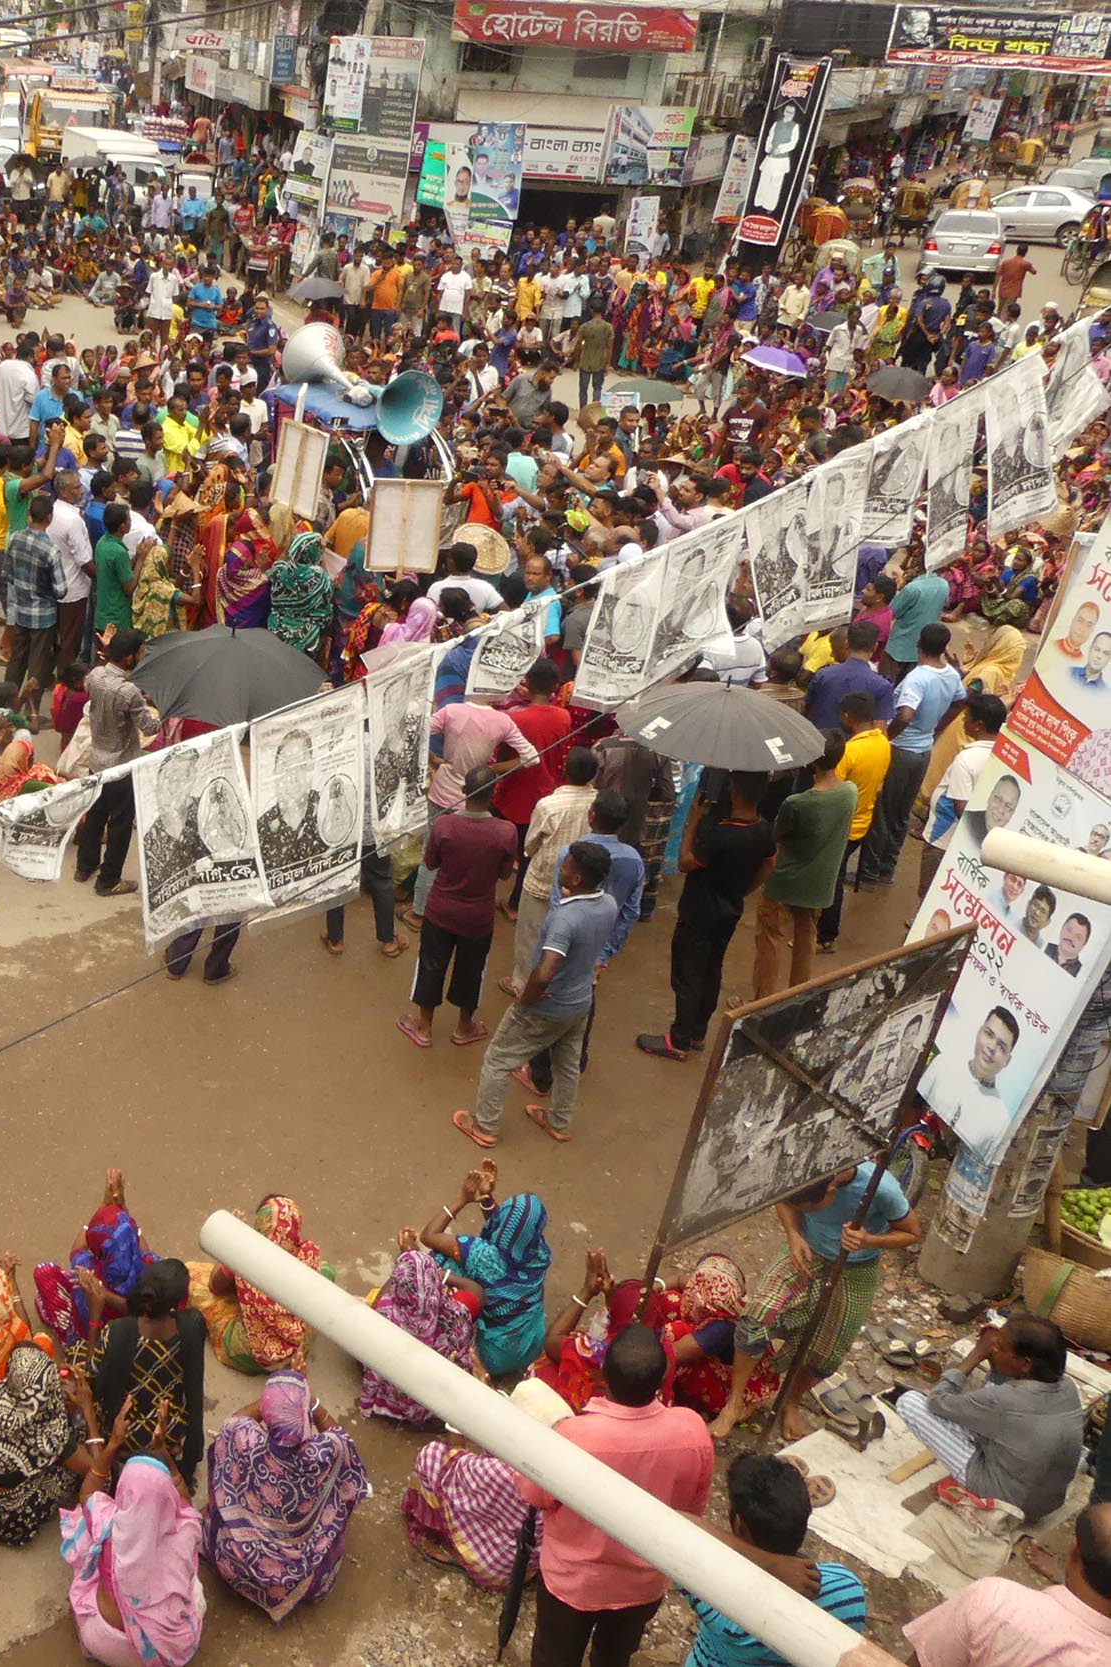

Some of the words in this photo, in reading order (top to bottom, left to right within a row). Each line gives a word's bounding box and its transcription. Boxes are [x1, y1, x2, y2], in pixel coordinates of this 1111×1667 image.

[482, 7, 567, 42] হোটেল
[573, 9, 647, 43] বিরতি
[185, 34, 222, 48] বাটা
[948, 34, 1001, 53] বিনম্র
[1003, 40, 1051, 55] শ্রদ্ধা
[569, 154, 588, 163] FAST
[957, 851, 990, 889] বার্ষিক
[940, 867, 1018, 956] সম্মেলন
